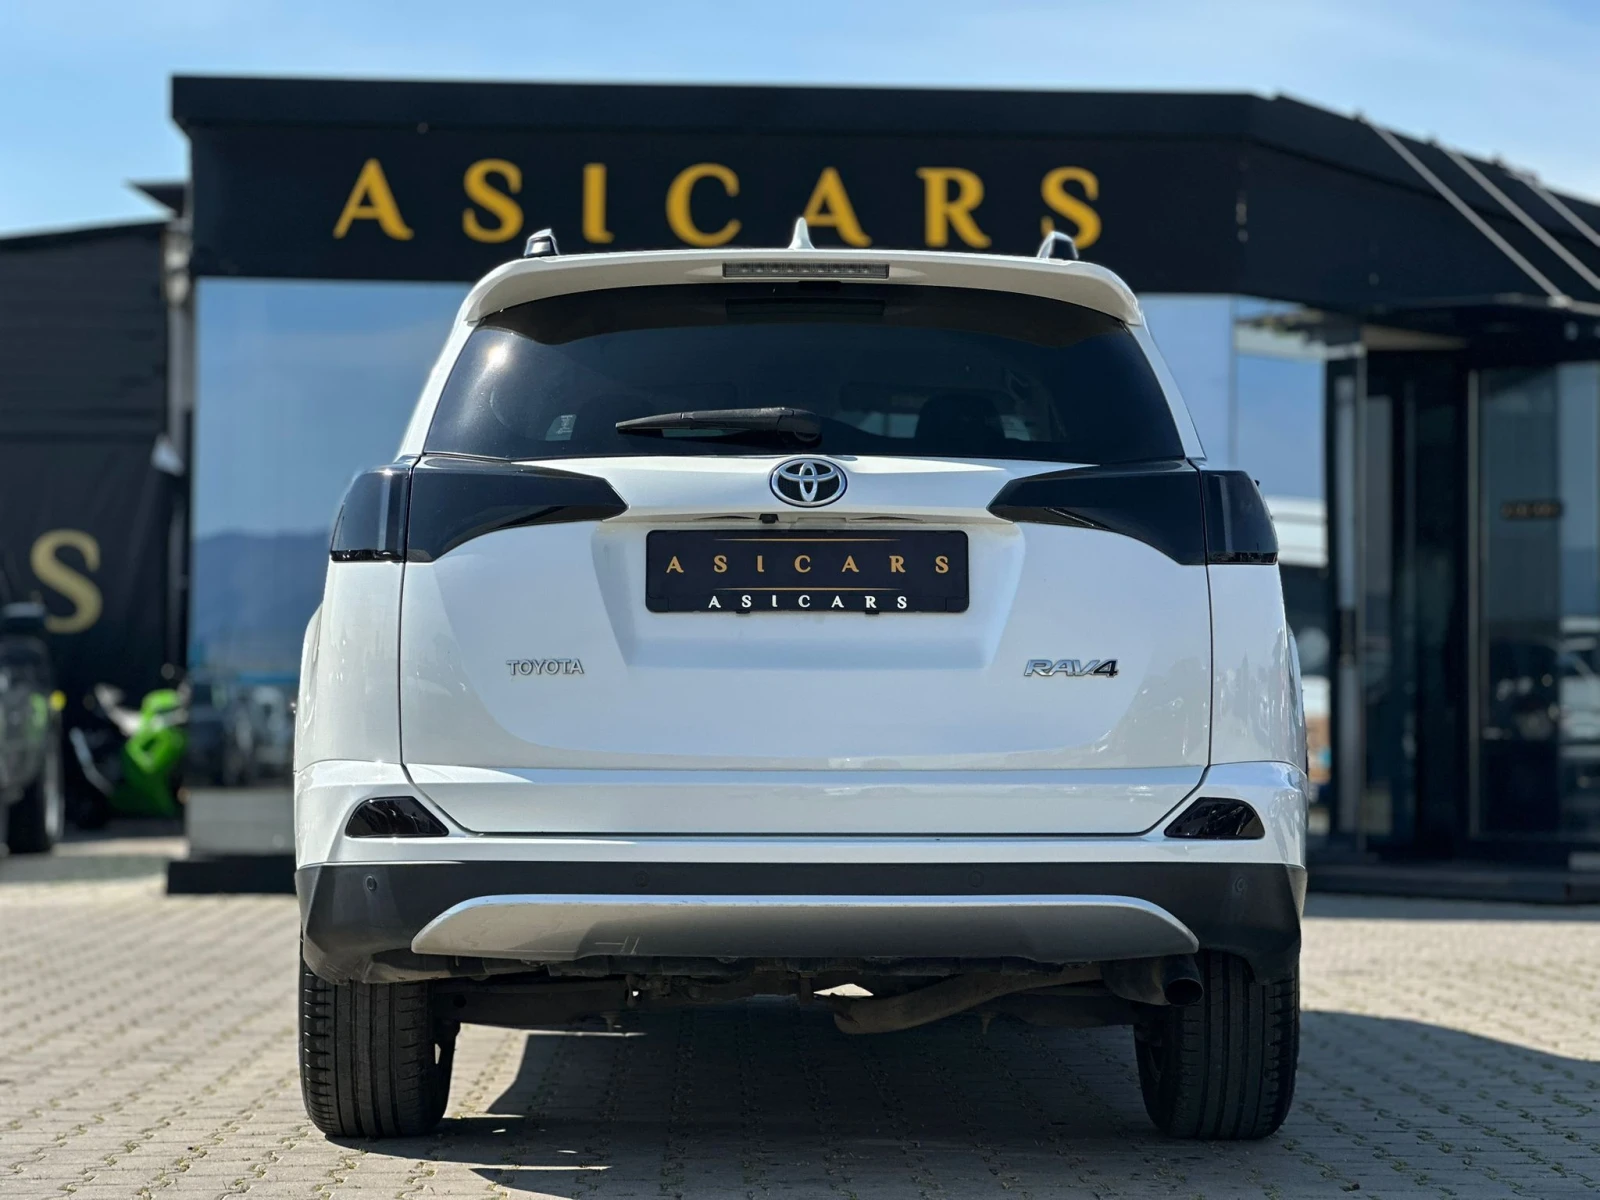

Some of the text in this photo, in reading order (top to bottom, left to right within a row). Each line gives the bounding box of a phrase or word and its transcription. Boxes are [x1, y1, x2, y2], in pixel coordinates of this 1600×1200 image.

[332, 158, 1103, 249] ASICARS
[666, 555, 950, 573] ASICARS
[708, 594, 908, 610] ASICARS
[506, 658, 584, 675] TOYOTA
[1024, 658, 1119, 678] RAV4
